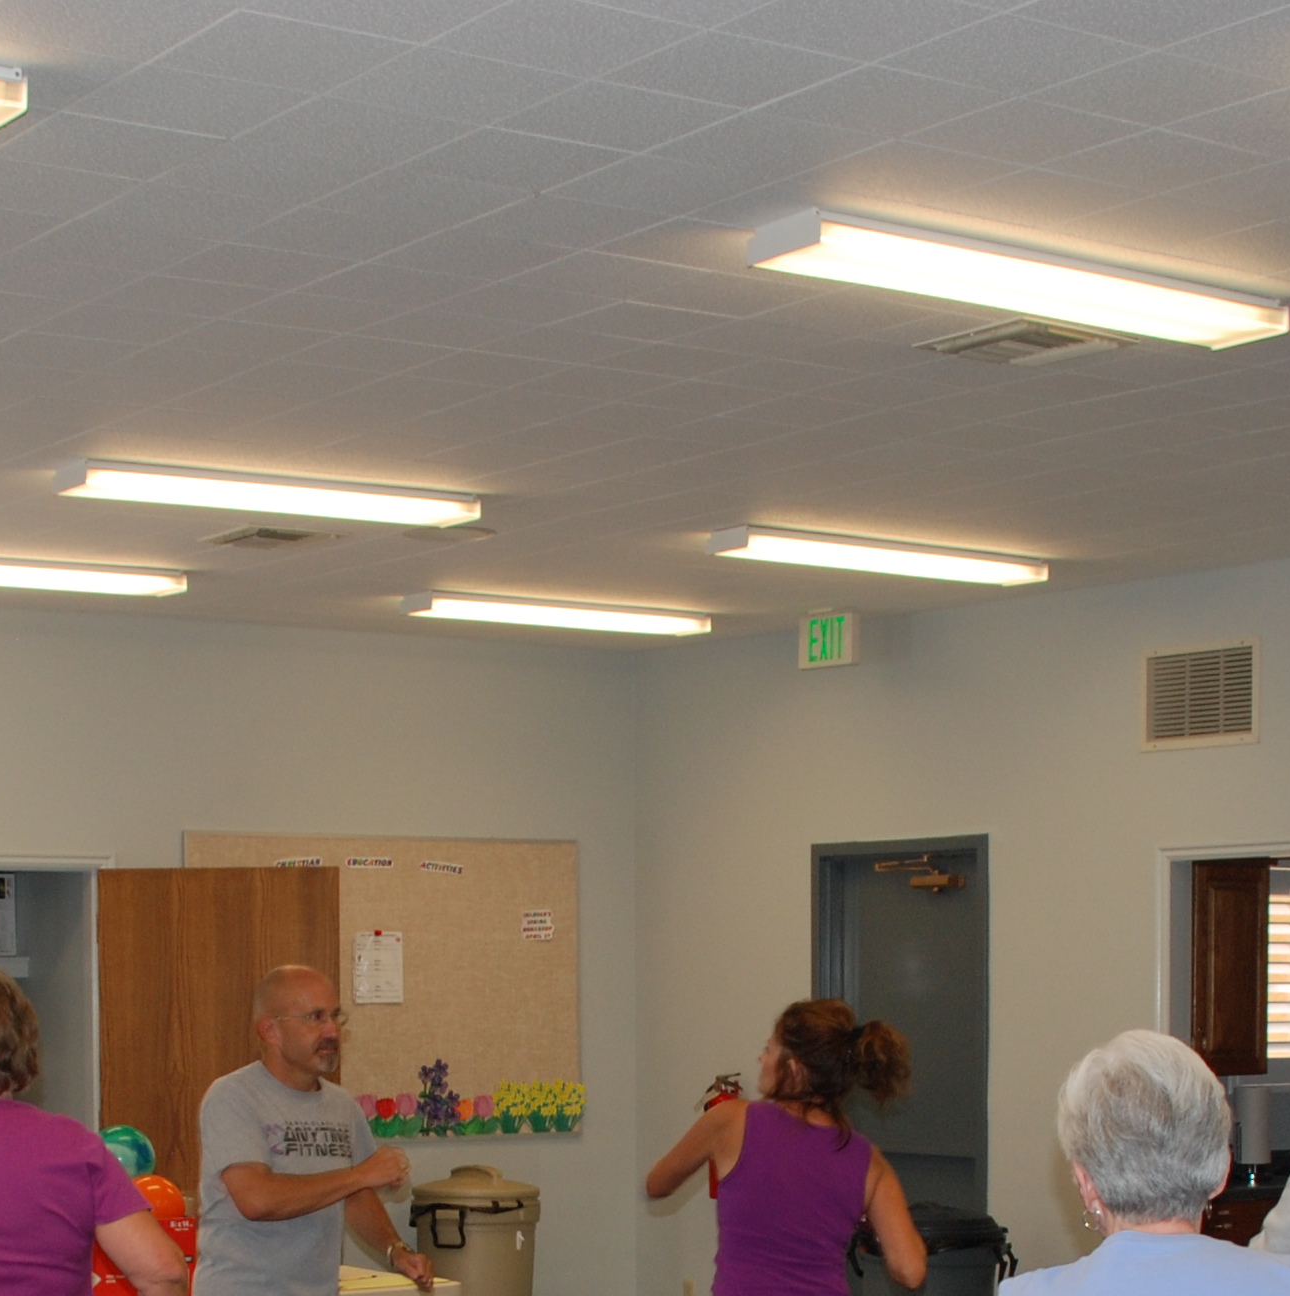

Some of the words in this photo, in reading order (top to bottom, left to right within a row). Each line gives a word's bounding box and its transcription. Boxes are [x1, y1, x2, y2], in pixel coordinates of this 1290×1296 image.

[809, 616, 845, 662] EXIT
[347, 858, 393, 867] EDUCATION
[420, 860, 464, 874] ACTIVITIES
[285, 1143, 352, 1158] FITNESS
